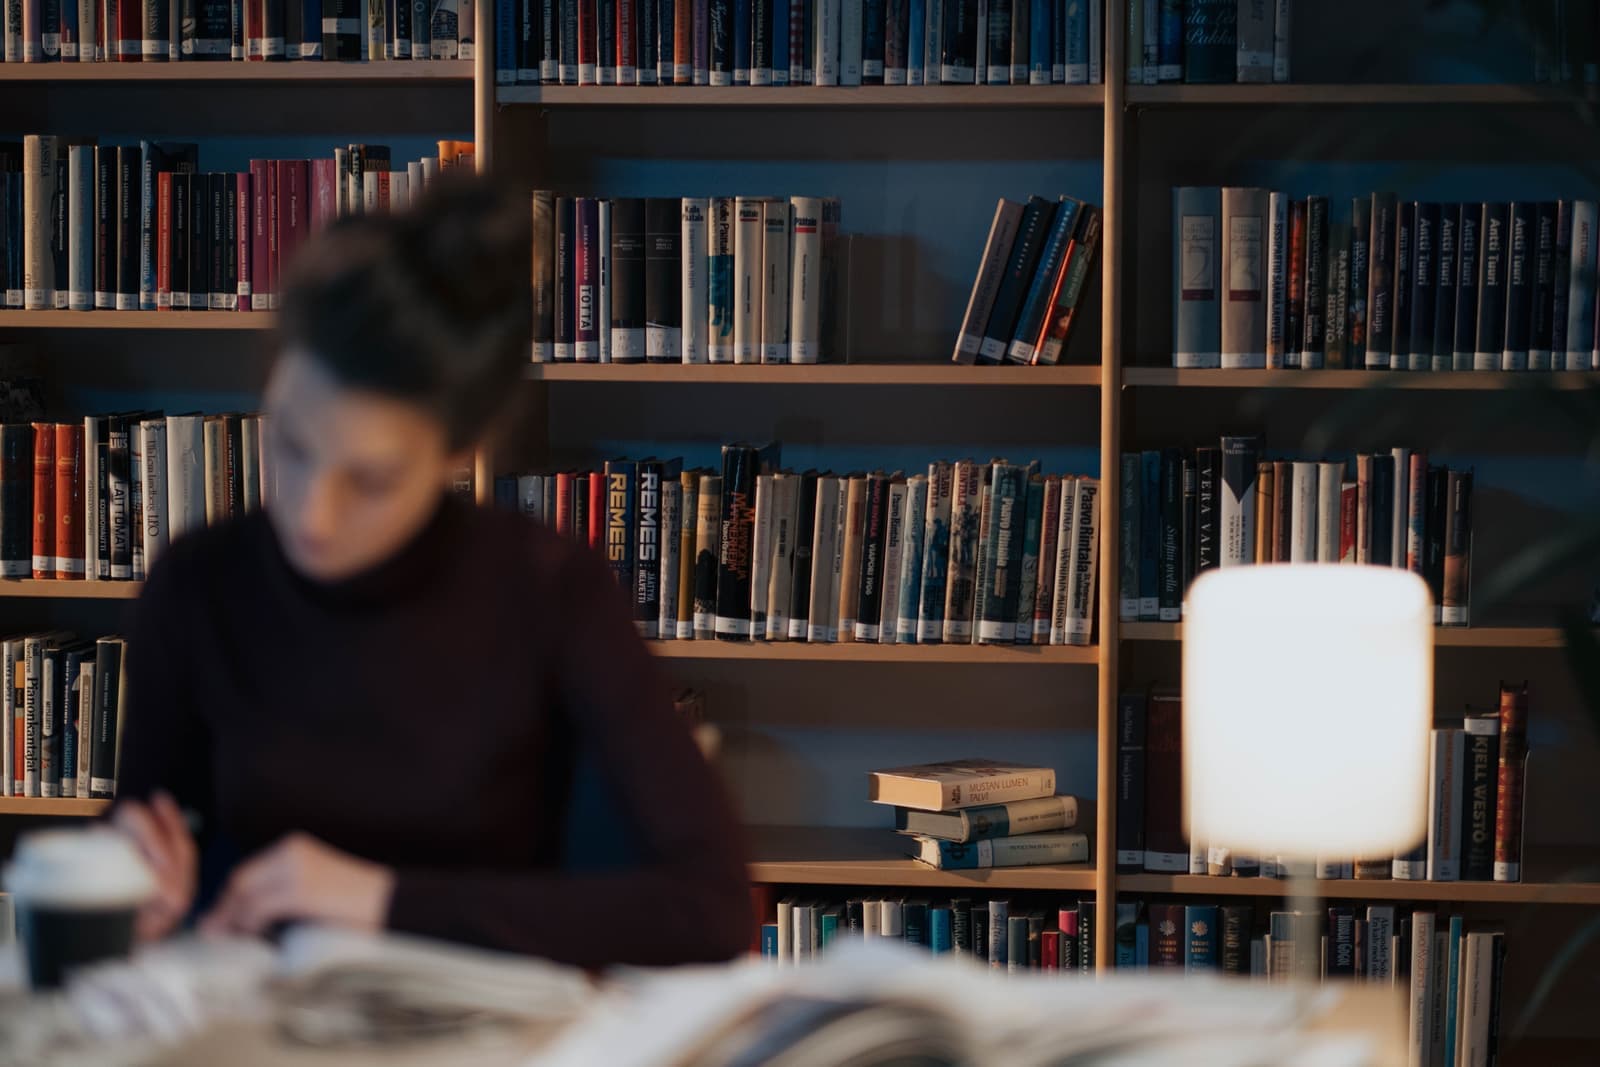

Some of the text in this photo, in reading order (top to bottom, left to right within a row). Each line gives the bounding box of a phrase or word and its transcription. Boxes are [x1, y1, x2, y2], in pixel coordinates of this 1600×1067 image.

[1418, 218, 1432, 286] Antti Tuuri
[1441, 218, 1454, 286] Antti Tuuri
[1462, 219, 1476, 286] Antti Tuuri
[1487, 218, 1500, 286] Antti Tuuri
[1512, 217, 1526, 286] Antti Tuuri
[1540, 216, 1552, 249] Antti
[582, 287, 592, 329] TOTTA
[1327, 294, 1336, 343] HIRVIÖ
[1336, 249, 1348, 340] RAKKAUDEN-
[970, 466, 978, 495] PAAVO
[1000, 498, 1014, 528] Paavo
[114, 480, 126, 552] LAITTOMAT
[147, 514, 160, 537] LEO
[608, 473, 628, 560] REMES
[640, 472, 658, 560] REMES
[721, 520, 730, 565] Paavo Rintala
[728, 492, 746, 572] MANNERHEIM
[890, 518, 900, 548] Rintala
[1064, 496, 1073, 532] RINTALA
[1077, 486, 1097, 572] Paavo Rintala
[1200, 468, 1212, 568] VERA VALA
[638, 570, 647, 604] HELVETTI
[866, 544, 877, 576] VIAPORI
[1164, 526, 1178, 592] Swiftin ovella
[25, 677, 39, 772] Pianonkantajat
[968, 778, 1028, 793] MUSTAN LUMEN
[968, 792, 990, 802] TALVI
[1472, 736, 1490, 842] KJELL WESTÖ
